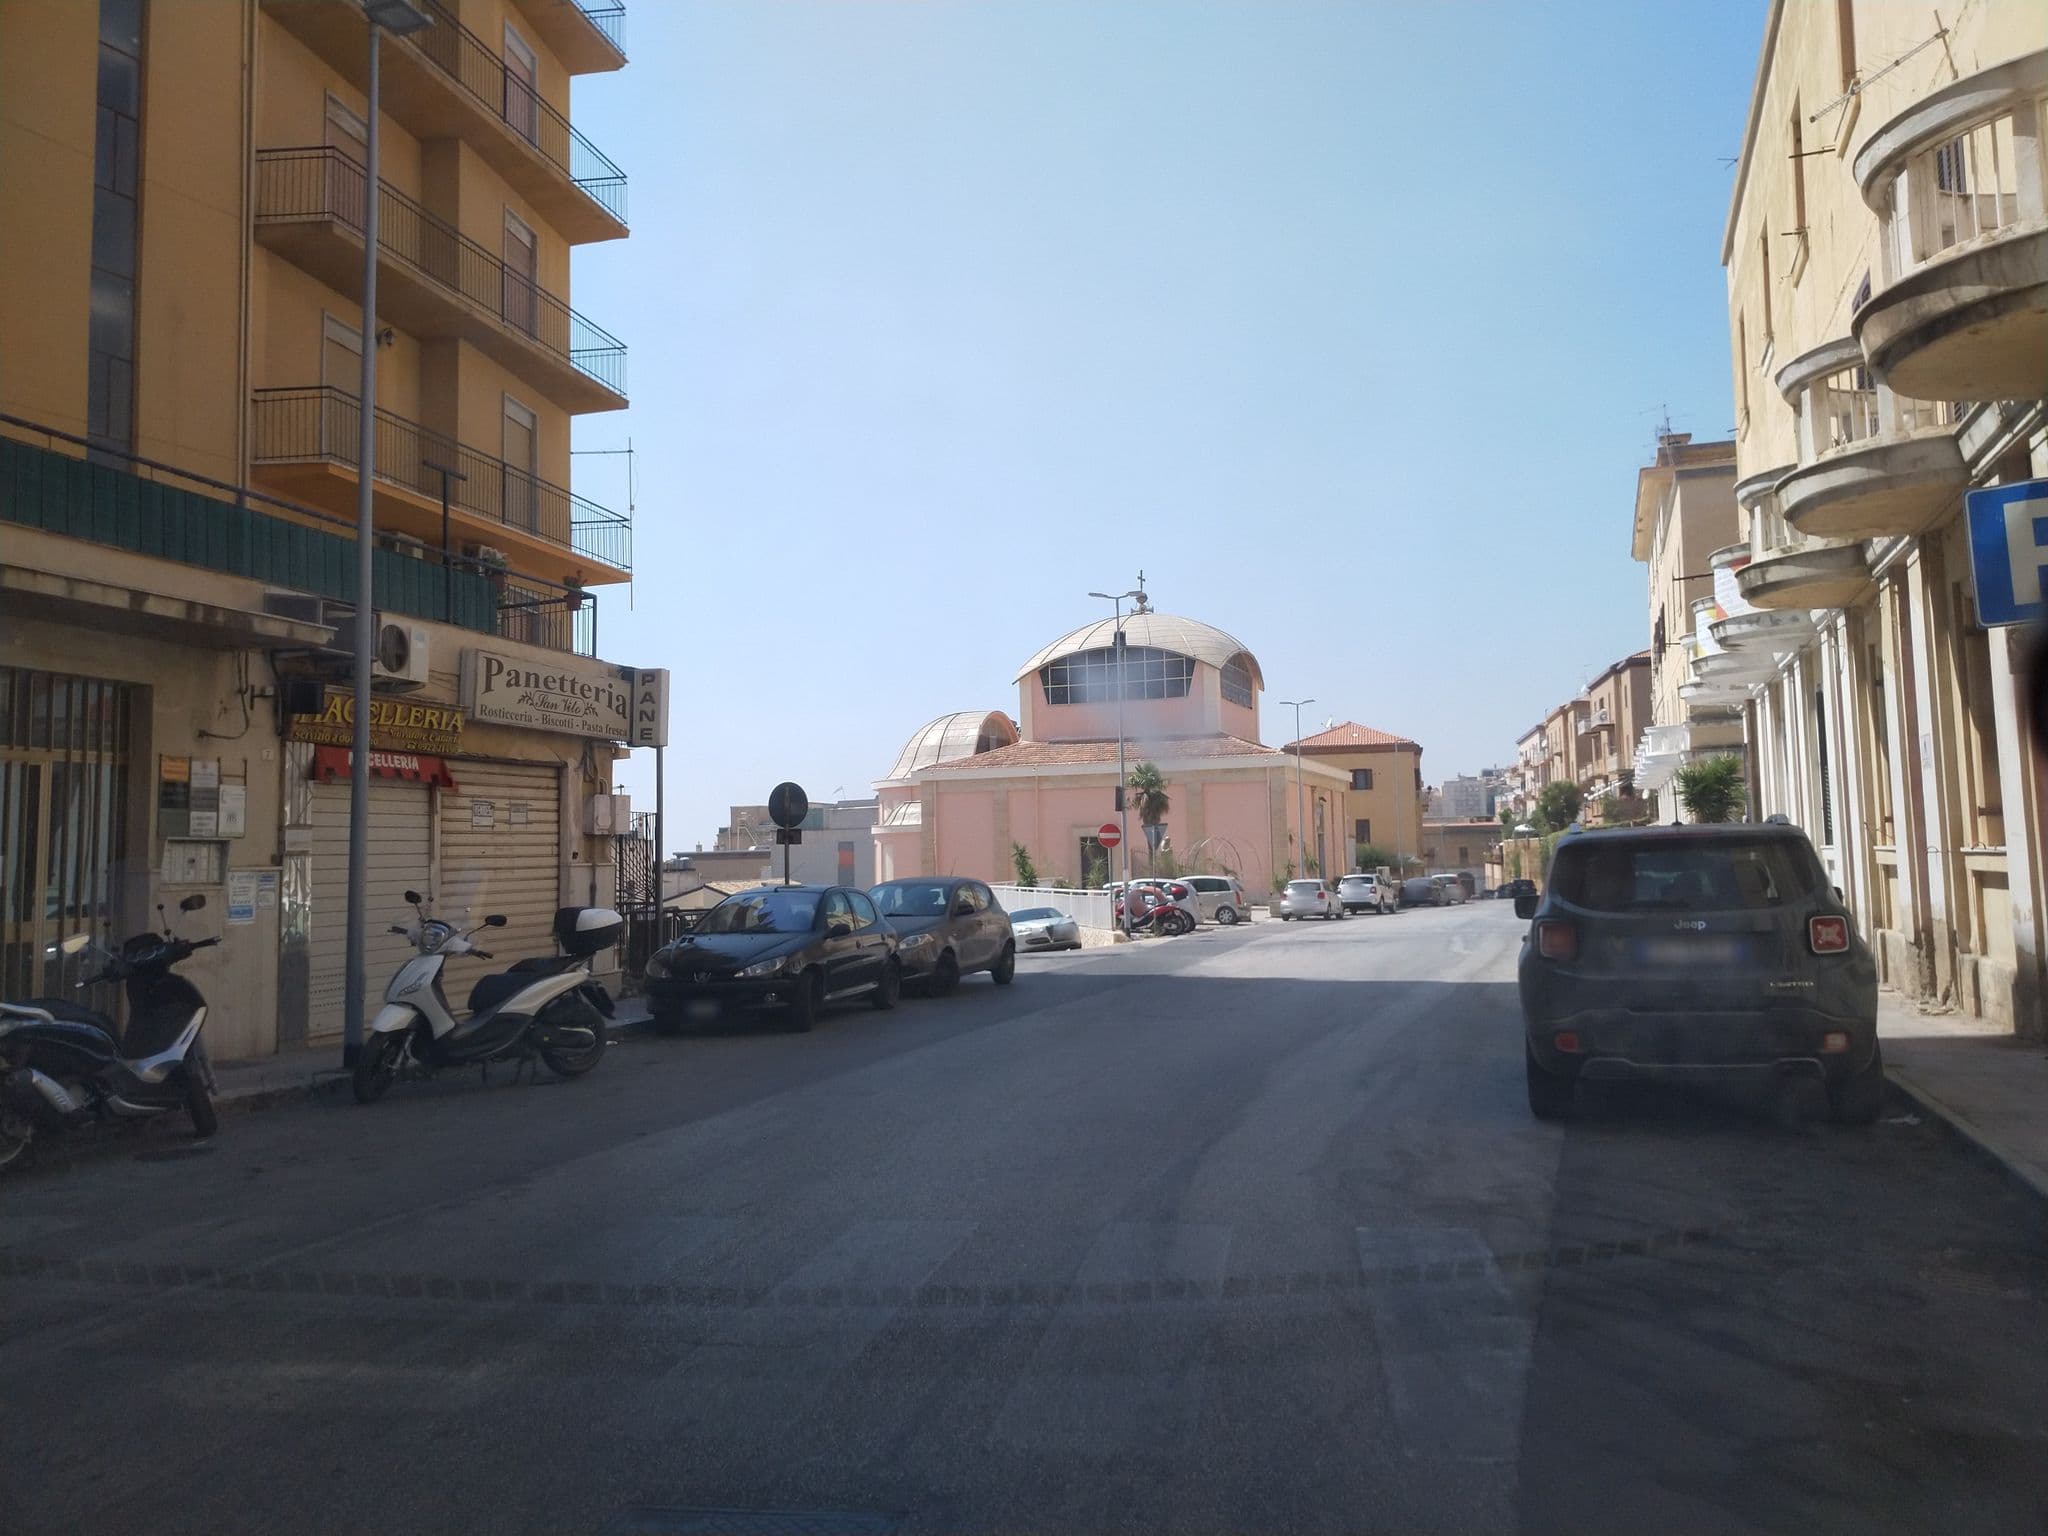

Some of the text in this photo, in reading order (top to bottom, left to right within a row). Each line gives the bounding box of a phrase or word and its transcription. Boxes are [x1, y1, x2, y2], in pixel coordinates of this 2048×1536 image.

[480, 656, 628, 720] Panetteria
[534, 693, 558, 710] San
[480, 703, 628, 737] Rosticceria Biscotti Pasta fresca
[639, 672, 656, 741] PANE
[348, 751, 420, 771] CELLERIA
[1674, 920, 1706, 931] Jeep
